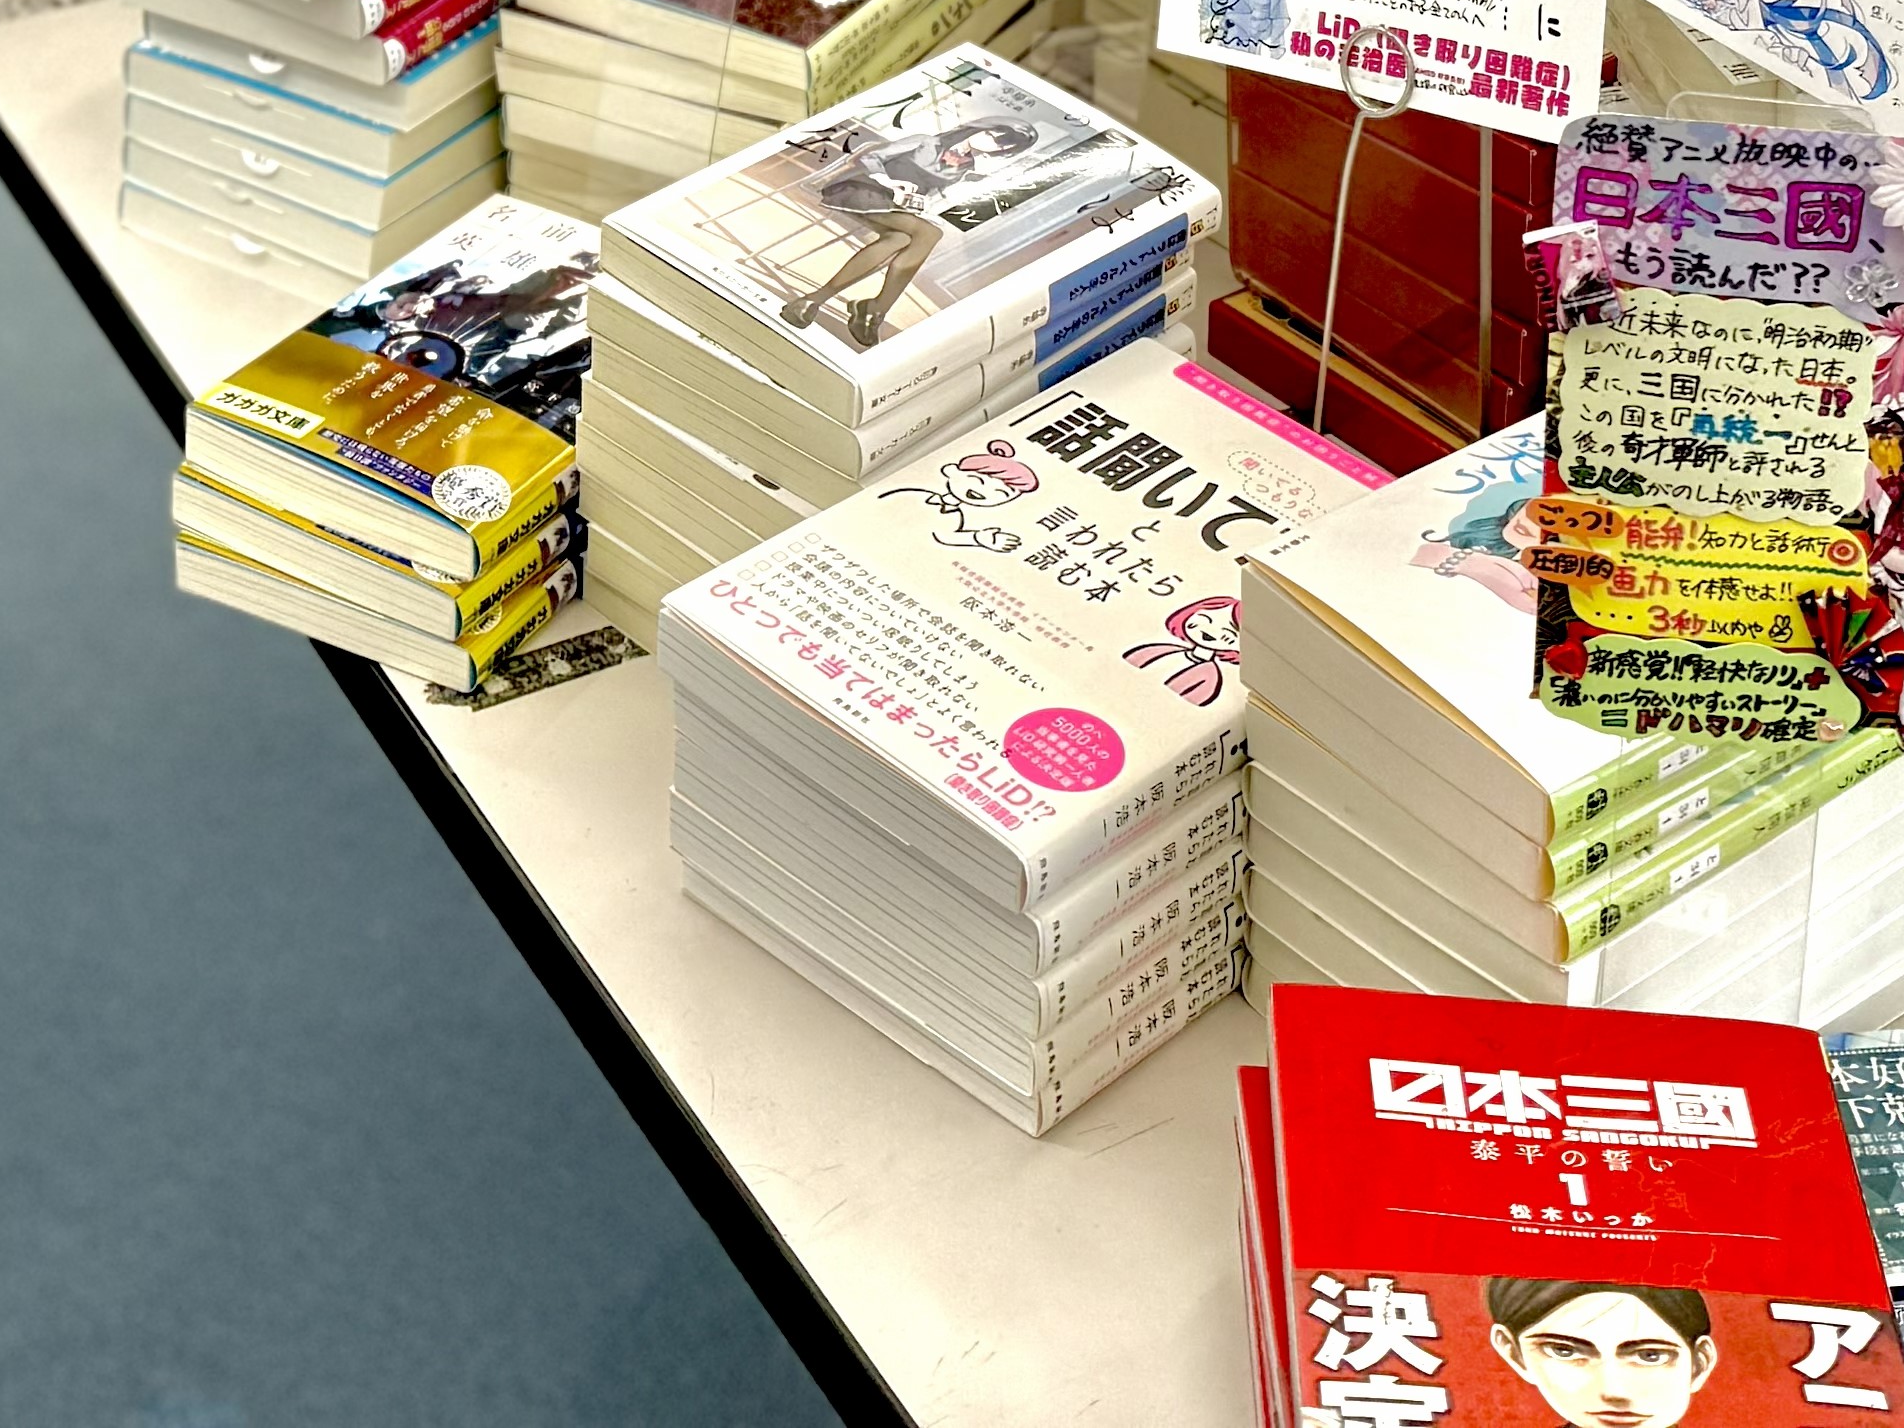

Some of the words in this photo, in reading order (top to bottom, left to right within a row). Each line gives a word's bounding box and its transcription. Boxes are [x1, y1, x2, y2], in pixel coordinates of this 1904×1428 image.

[1469, 72, 1572, 119] 最新著作
[1614, 240, 1832, 296] もう読んだ??
[1583, 339, 1858, 386] レベルの文明になった日本。
[214, 388, 314, 433] ガガガ文庫
[1023, 540, 1126, 606] 読む本
[1528, 546, 1616, 579] 圧倒的
[958, 593, 1034, 645] 阪本浩一
[1367, 1056, 1758, 1142] 日本三國
[1468, 1138, 1676, 1174] 泰平の誓い
[1557, 1171, 1591, 1208] 1
[1506, 1201, 1657, 1229] 松木いっか
